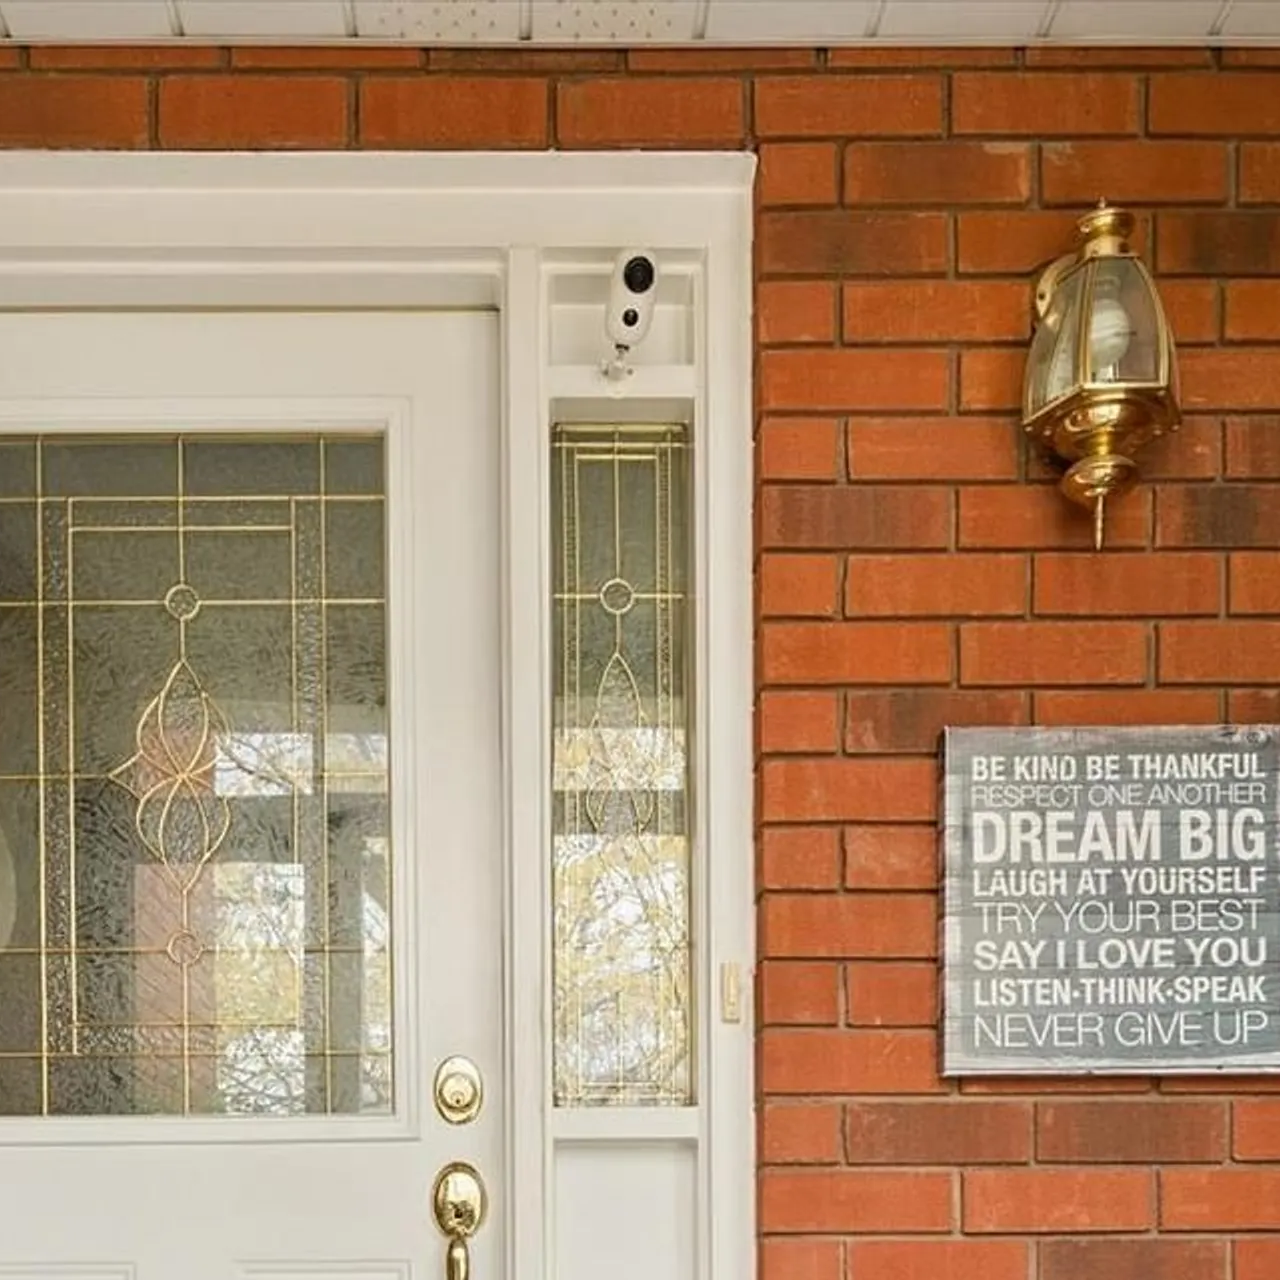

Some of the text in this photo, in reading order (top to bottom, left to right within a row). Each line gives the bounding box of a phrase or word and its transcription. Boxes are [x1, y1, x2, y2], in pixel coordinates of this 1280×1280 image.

[972, 753, 1266, 781] BE KIND BE THANKFUL
[972, 782, 1266, 807] RESPECT ONE ANOTHER
[972, 808, 1266, 863] DREAM BIG
[974, 866, 1266, 897] LAUGH AT YOURSELF
[972, 899, 1265, 934] TRY YOUR BEST
[974, 937, 1266, 971] SAY I LOVE YOU
[974, 1010, 1268, 1048] NEVER GIVE UP
